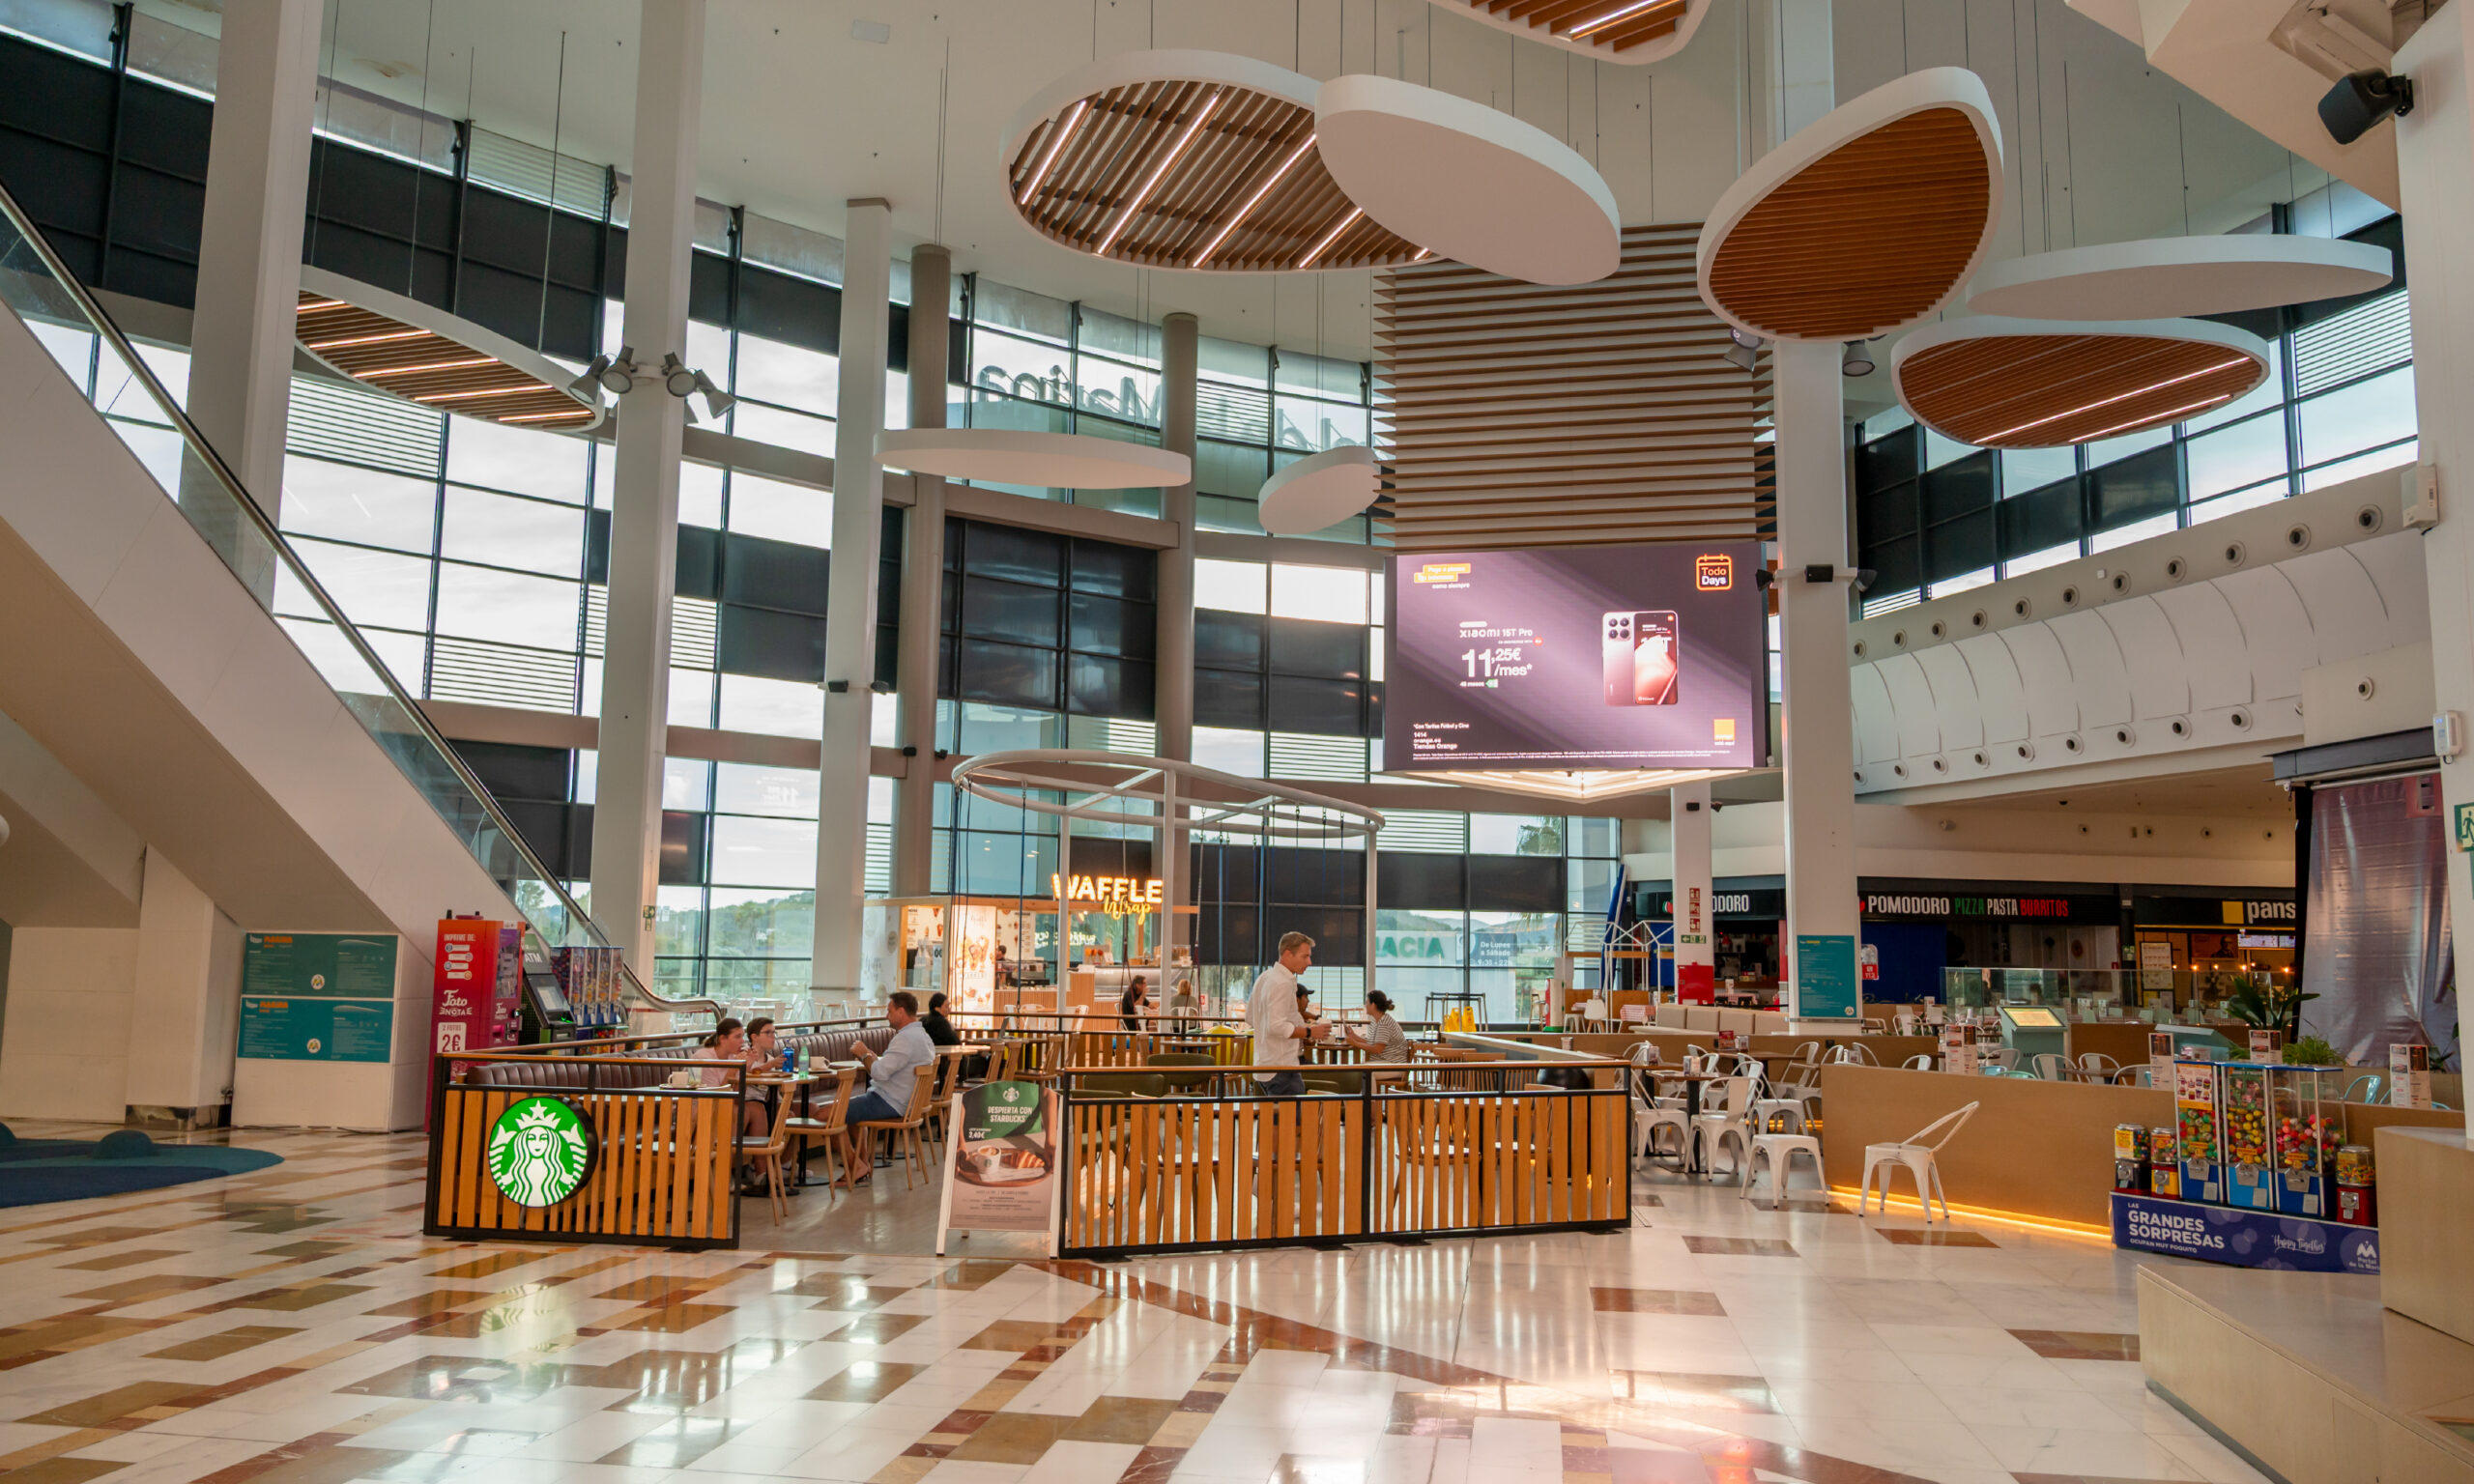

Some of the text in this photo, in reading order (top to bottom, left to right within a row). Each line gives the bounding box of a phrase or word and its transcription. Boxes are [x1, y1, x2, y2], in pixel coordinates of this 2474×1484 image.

[1701, 566, 1727, 576] Todo
[1701, 575, 1727, 586] Days
[1518, 628, 1534, 638] Pro
[1051, 873, 1164, 903] WAFFLE
[1103, 895, 1152, 926] Wrap
[1868, 896, 2069, 917] POMODORO PIZZA PASTA BURRITOS
[2246, 900, 2296, 925] pans
[525, 952, 543, 963] ATM
[442, 988, 469, 1007] Foto
[2128, 1211, 2205, 1233] GRANDES
[2129, 1223, 2225, 1249] SORPRESAS
[2130, 1239, 2155, 1247] OCUPAN
[2170, 1243, 2198, 1254] POQUITO
